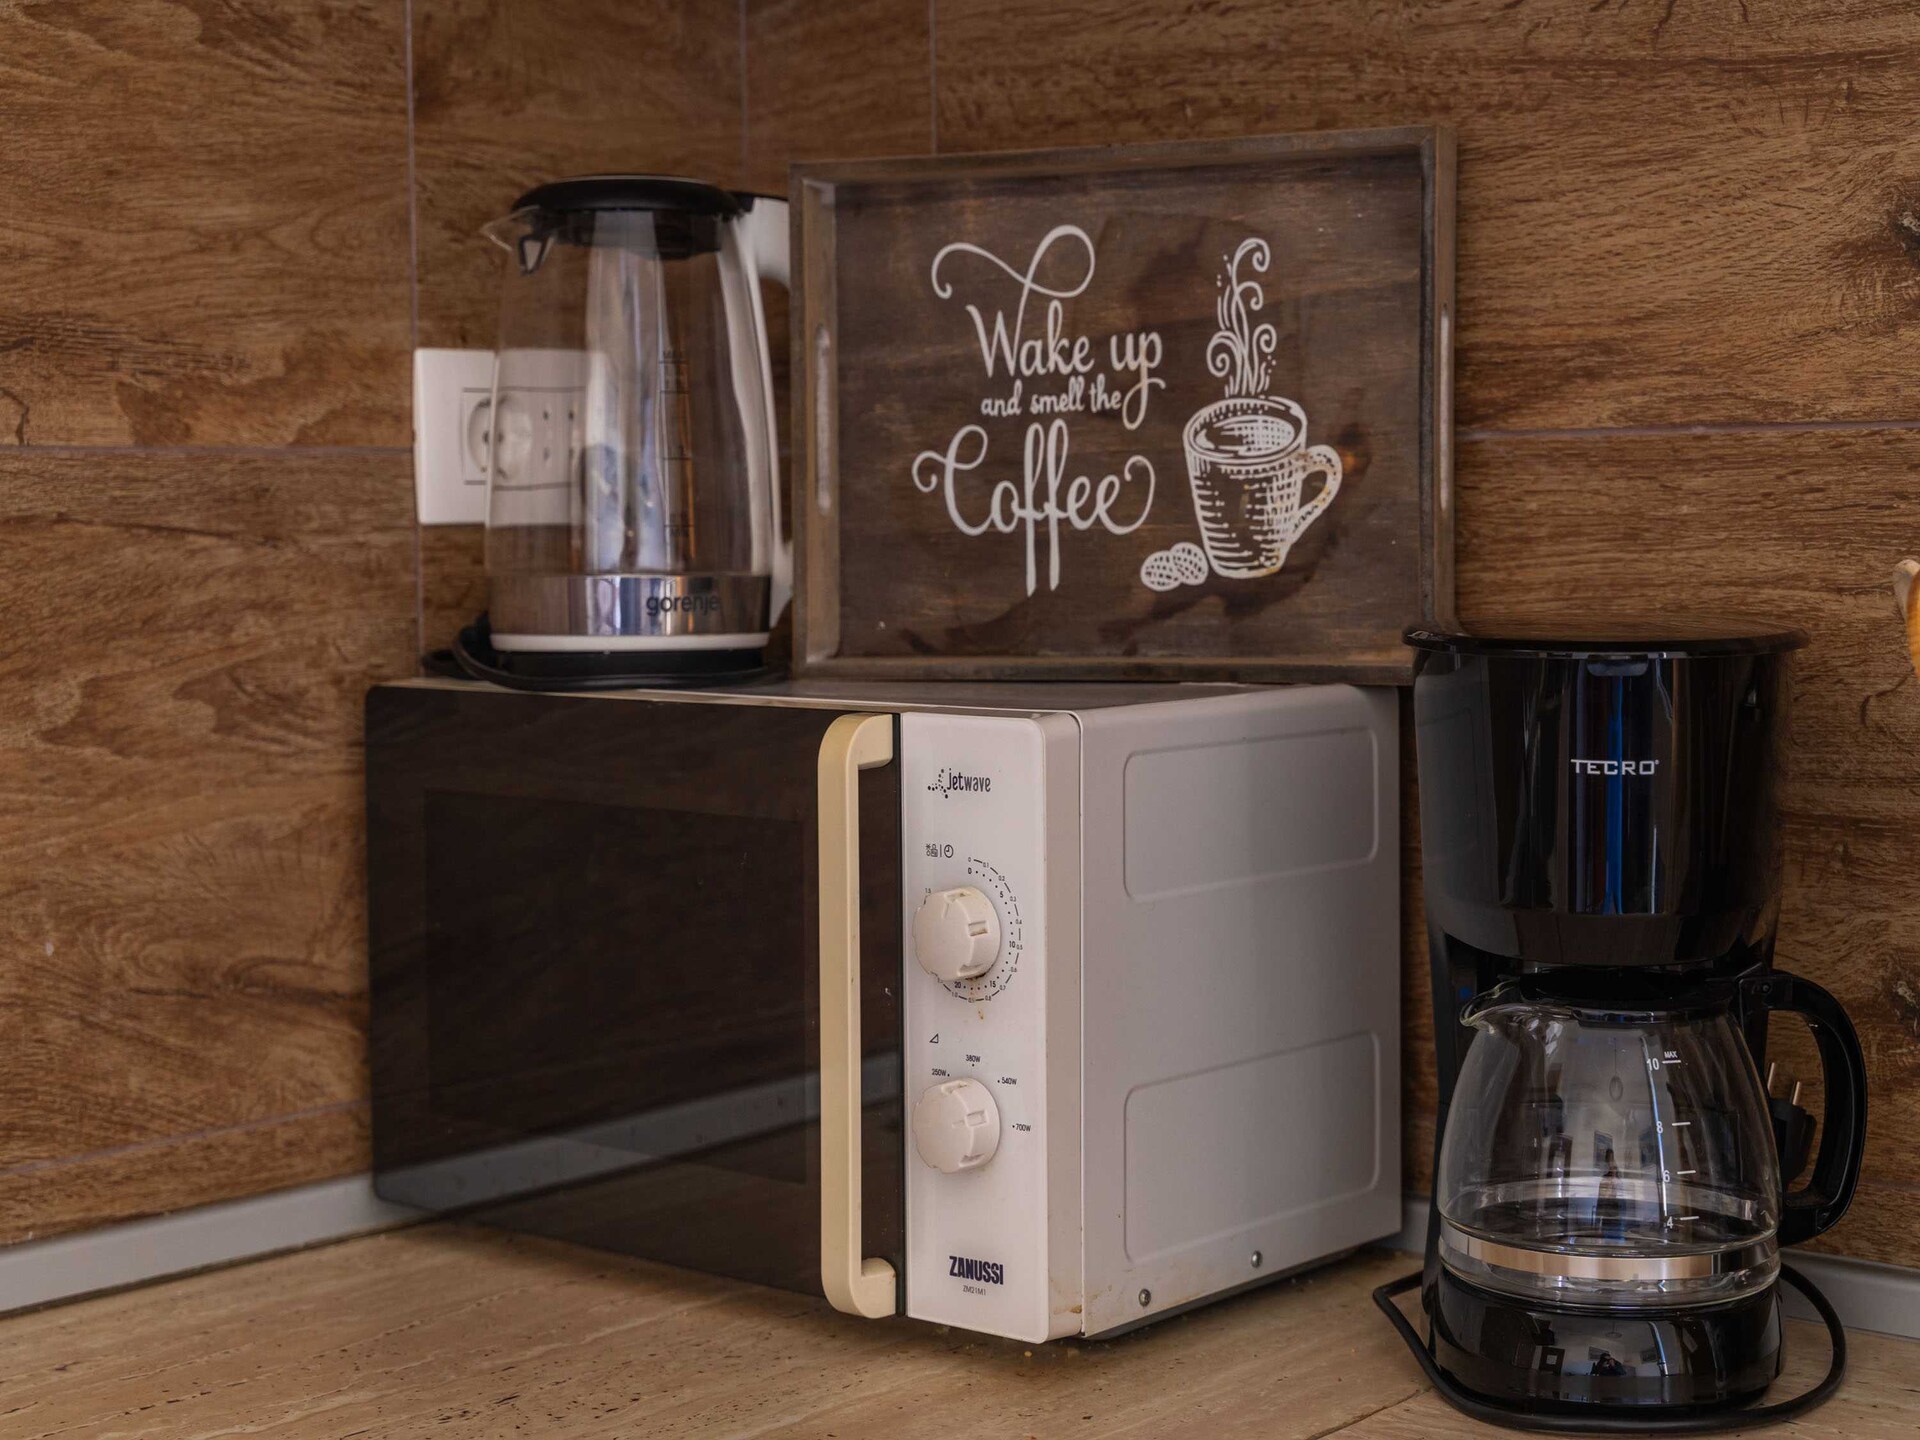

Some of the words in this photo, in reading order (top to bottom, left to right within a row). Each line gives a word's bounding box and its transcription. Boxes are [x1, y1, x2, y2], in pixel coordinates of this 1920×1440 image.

[931, 225, 1095, 378] Wake
[1110, 331, 1166, 430] up
[980, 379, 1023, 417] and
[1029, 375, 1085, 414] smell
[1088, 373, 1122, 413] the
[912, 418, 1155, 597] Coffee
[646, 593, 721, 617] gorenje
[946, 767, 991, 792] jetwave
[1008, 940, 1016, 949] 10
[953, 981, 962, 989] 20
[989, 980, 997, 988] 15
[965, 1054, 981, 1063] 380W
[1663, 1050, 1678, 1059] MAX
[1646, 1057, 1660, 1071] 10
[931, 1068, 947, 1077] 250W
[1001, 1076, 1018, 1086] 540W
[1015, 1123, 1031, 1132] 700W
[1656, 1120, 1664, 1134] 8
[1662, 1169, 1671, 1183] 6
[1666, 1215, 1674, 1229] 4
[949, 1255, 1004, 1286] ZANUSSI
